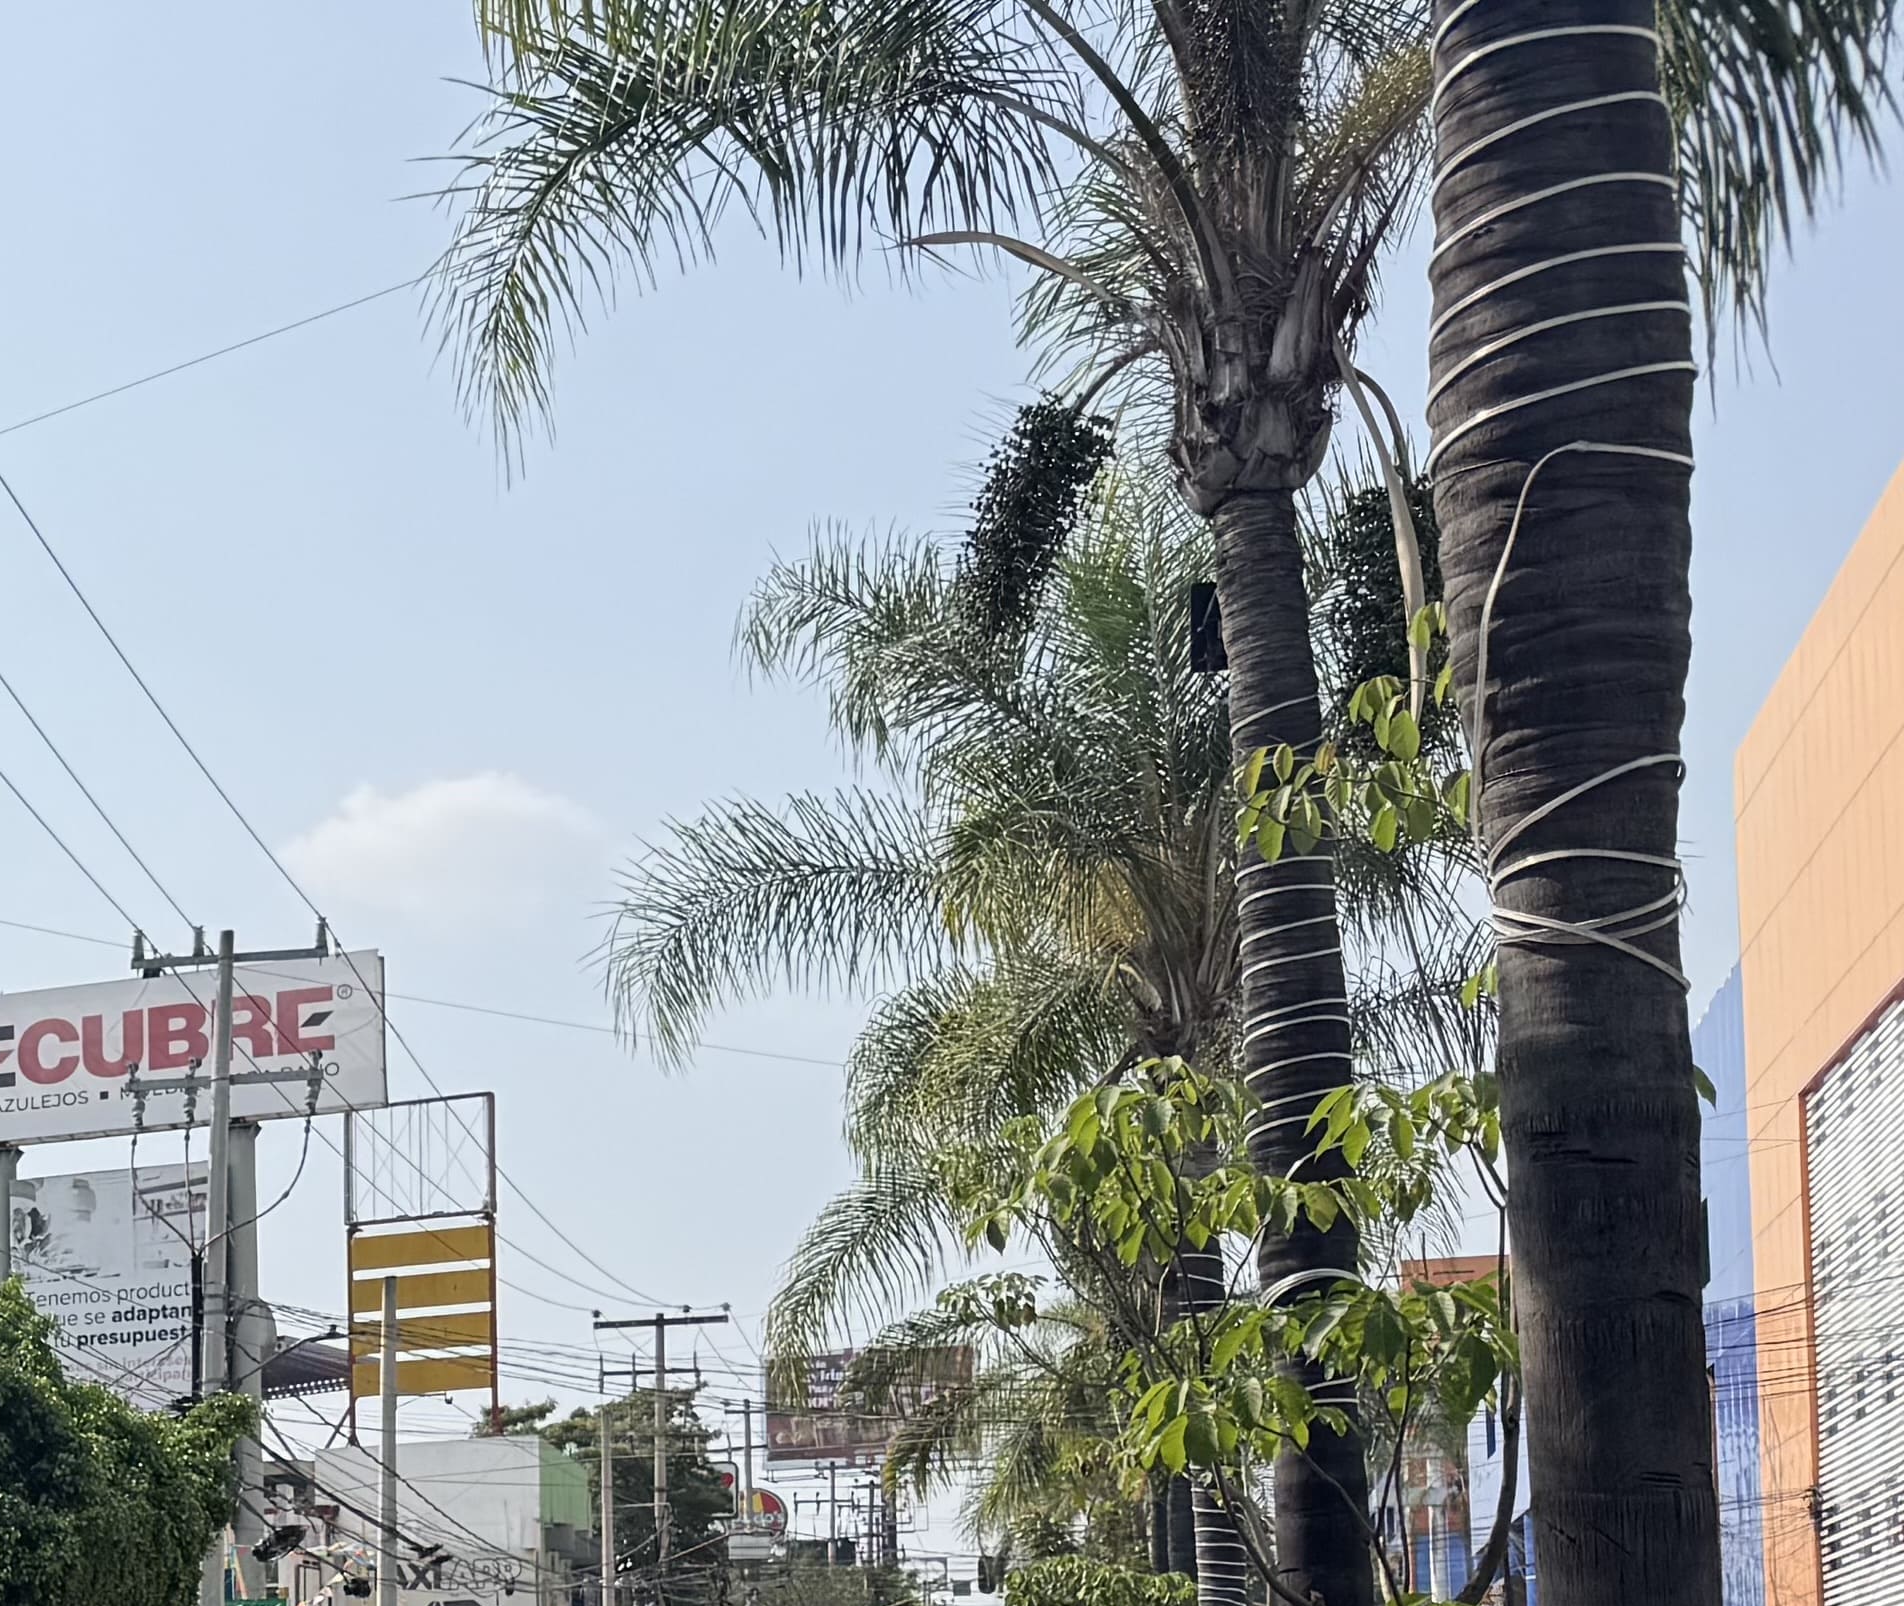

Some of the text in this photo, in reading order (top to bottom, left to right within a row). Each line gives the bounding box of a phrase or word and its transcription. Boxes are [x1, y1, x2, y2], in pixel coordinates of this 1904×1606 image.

[117, 1281, 192, 1304] product
[55, 1312, 79, 1328] ue
[84, 1311, 106, 1325] se
[76, 1324, 189, 1350] presupuest
[395, 1562, 440, 1591] AXI
